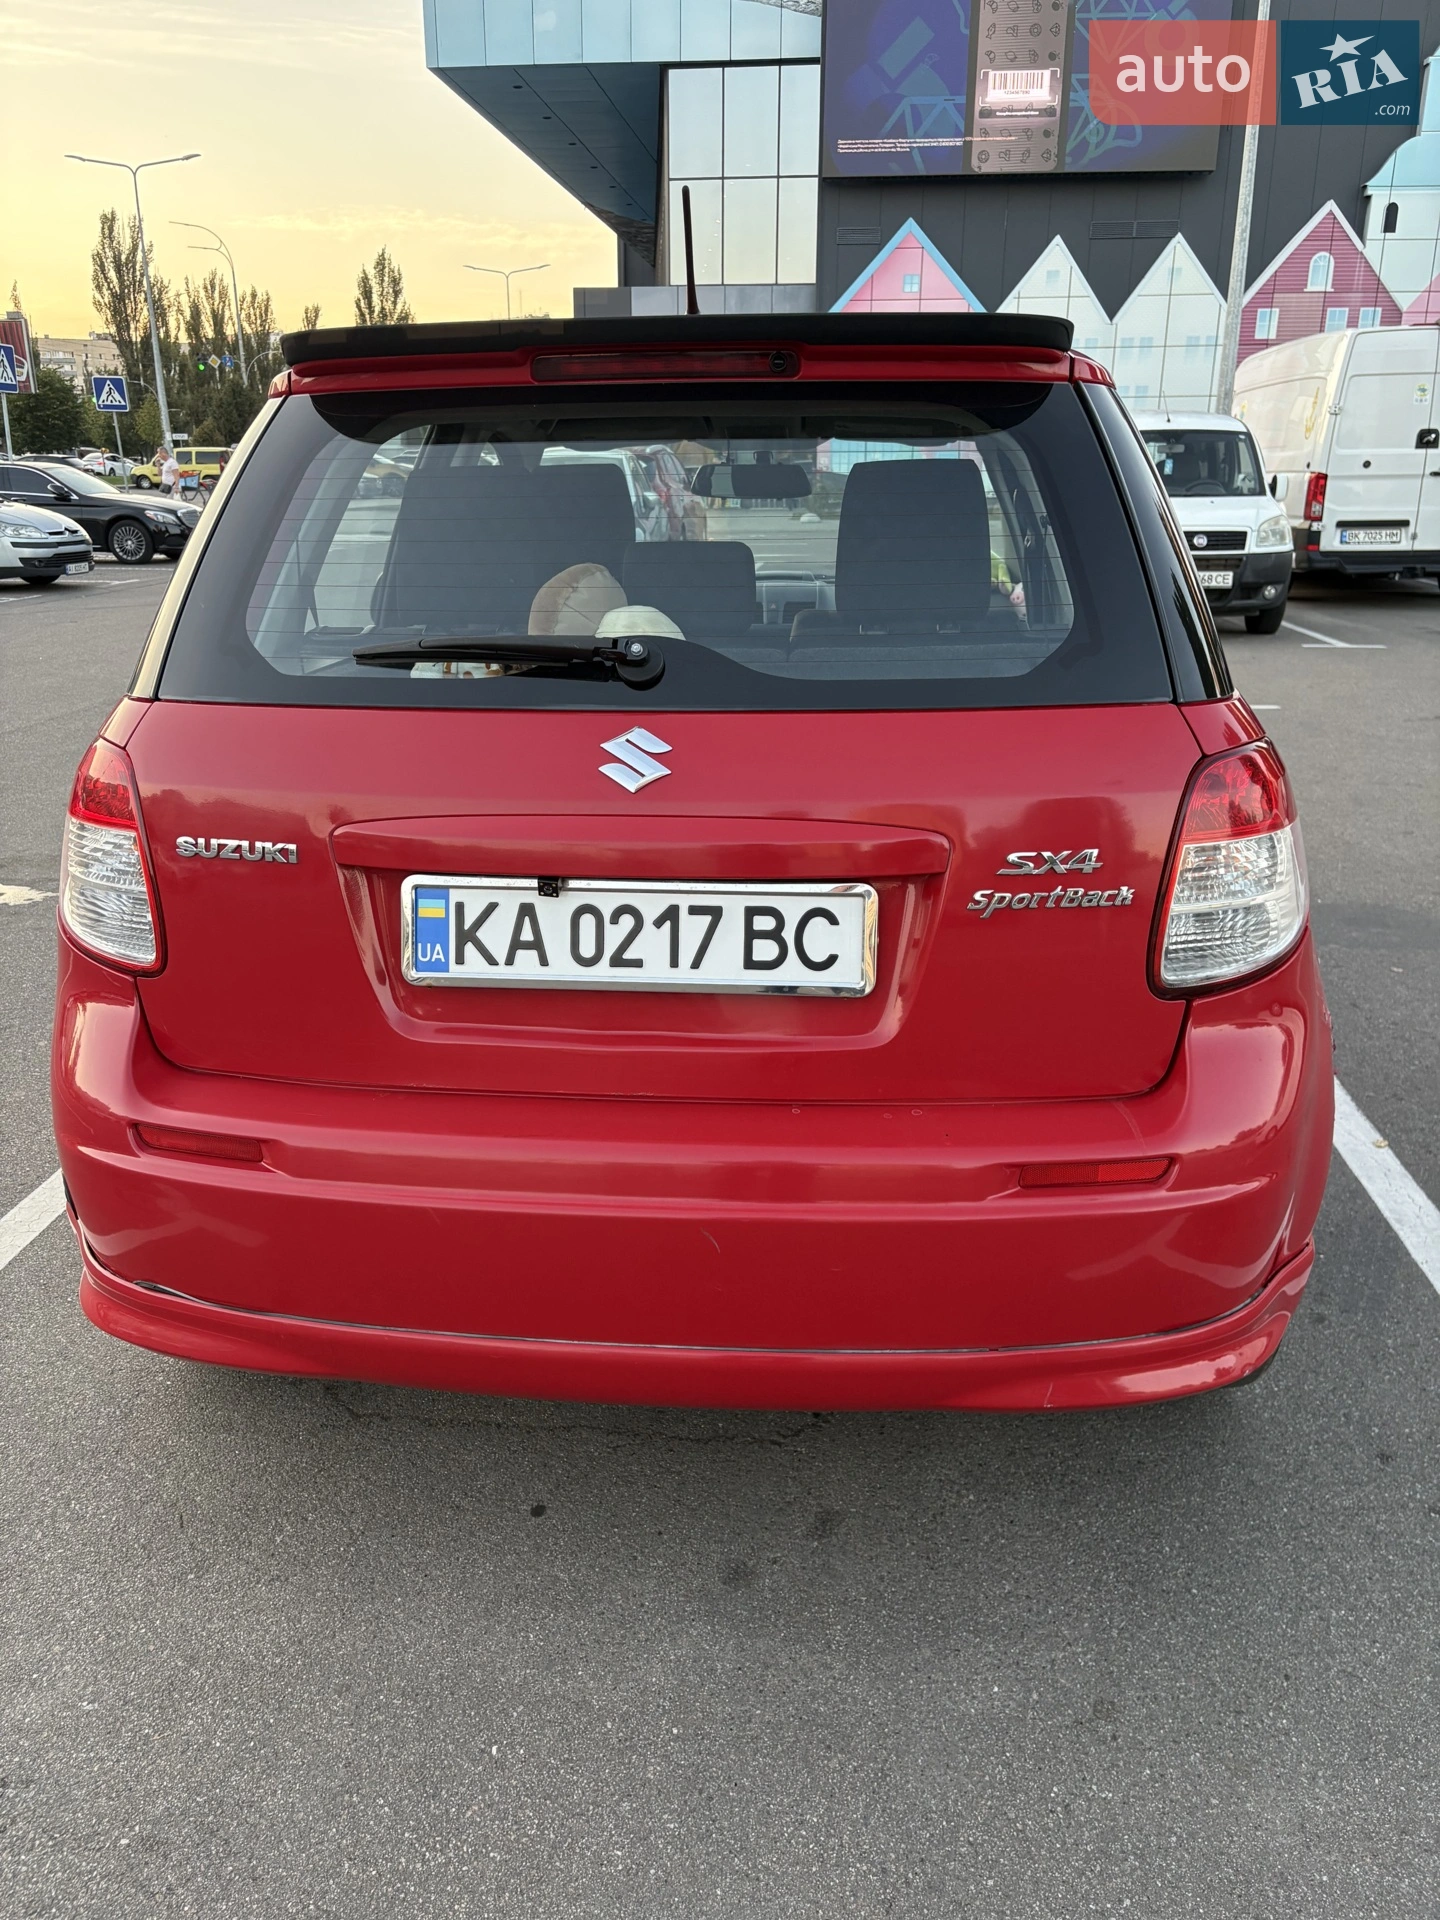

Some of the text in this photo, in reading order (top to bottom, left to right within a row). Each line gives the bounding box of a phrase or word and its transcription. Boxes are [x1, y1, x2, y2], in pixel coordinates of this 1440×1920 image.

[1347, 531, 1361, 541] BK
[1362, 531, 1383, 541] 7025
[1199, 573, 1231, 585] 68 CE
[175, 836, 298, 864] SUZUKI
[996, 848, 1103, 875] SX4
[967, 885, 1136, 919] SportBack
[453, 900, 841, 972] KA 0217 BC
[417, 942, 446, 963] UA
